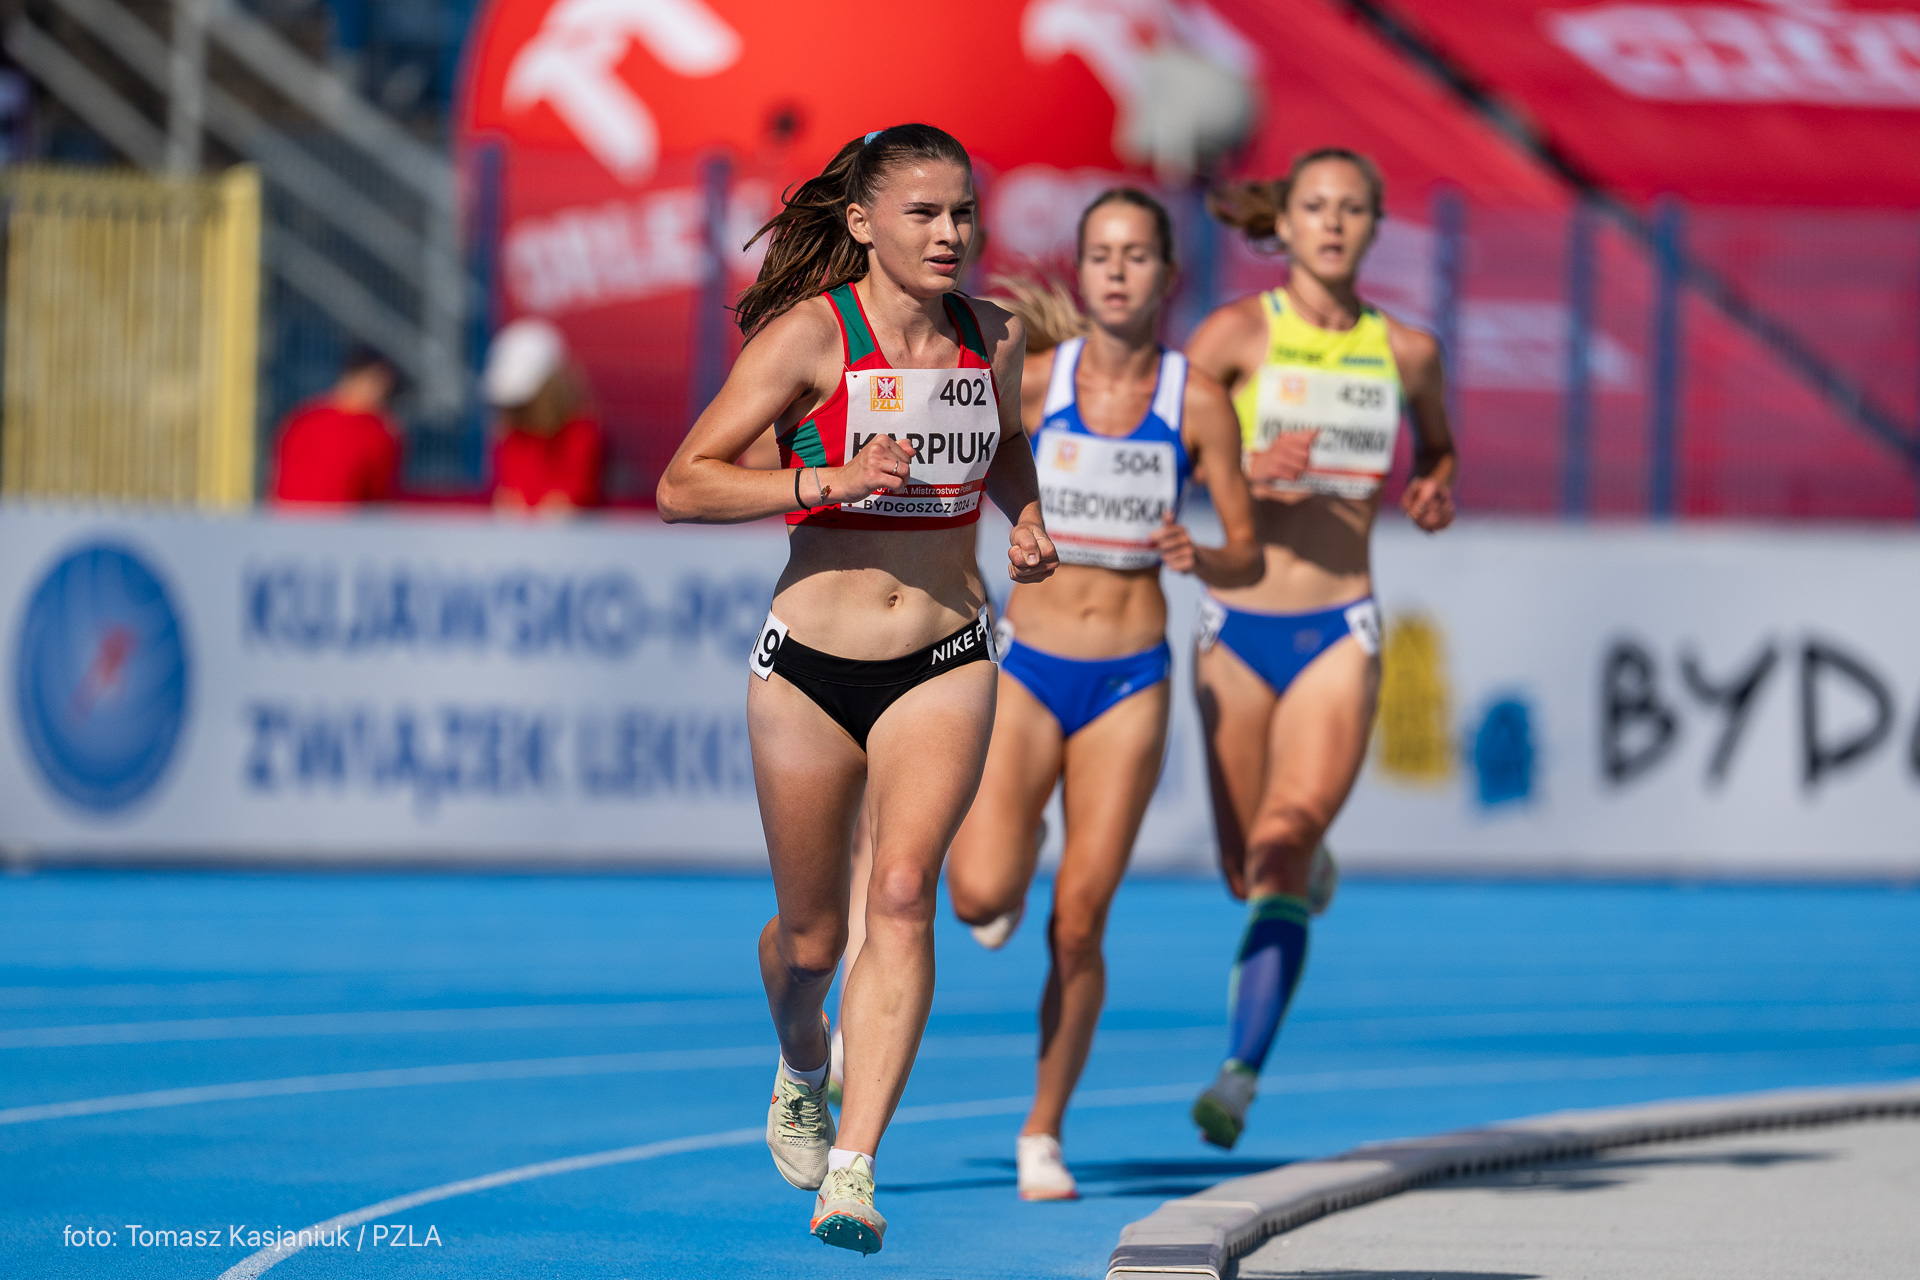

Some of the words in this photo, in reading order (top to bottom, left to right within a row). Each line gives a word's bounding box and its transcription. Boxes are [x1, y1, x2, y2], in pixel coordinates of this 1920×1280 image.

[872, 399, 902, 410] PZLA
[939, 378, 987, 407] 402
[852, 431, 996, 465] KRPIUK
[1113, 449, 1162, 475] 504
[910, 485, 960, 496] Mistrzostwa
[863, 499, 951, 514] BYDGOSZCZ
[953, 498, 970, 513] 2024
[931, 629, 975, 665] NIKE
[1599, 622, 1920, 795] BYD
